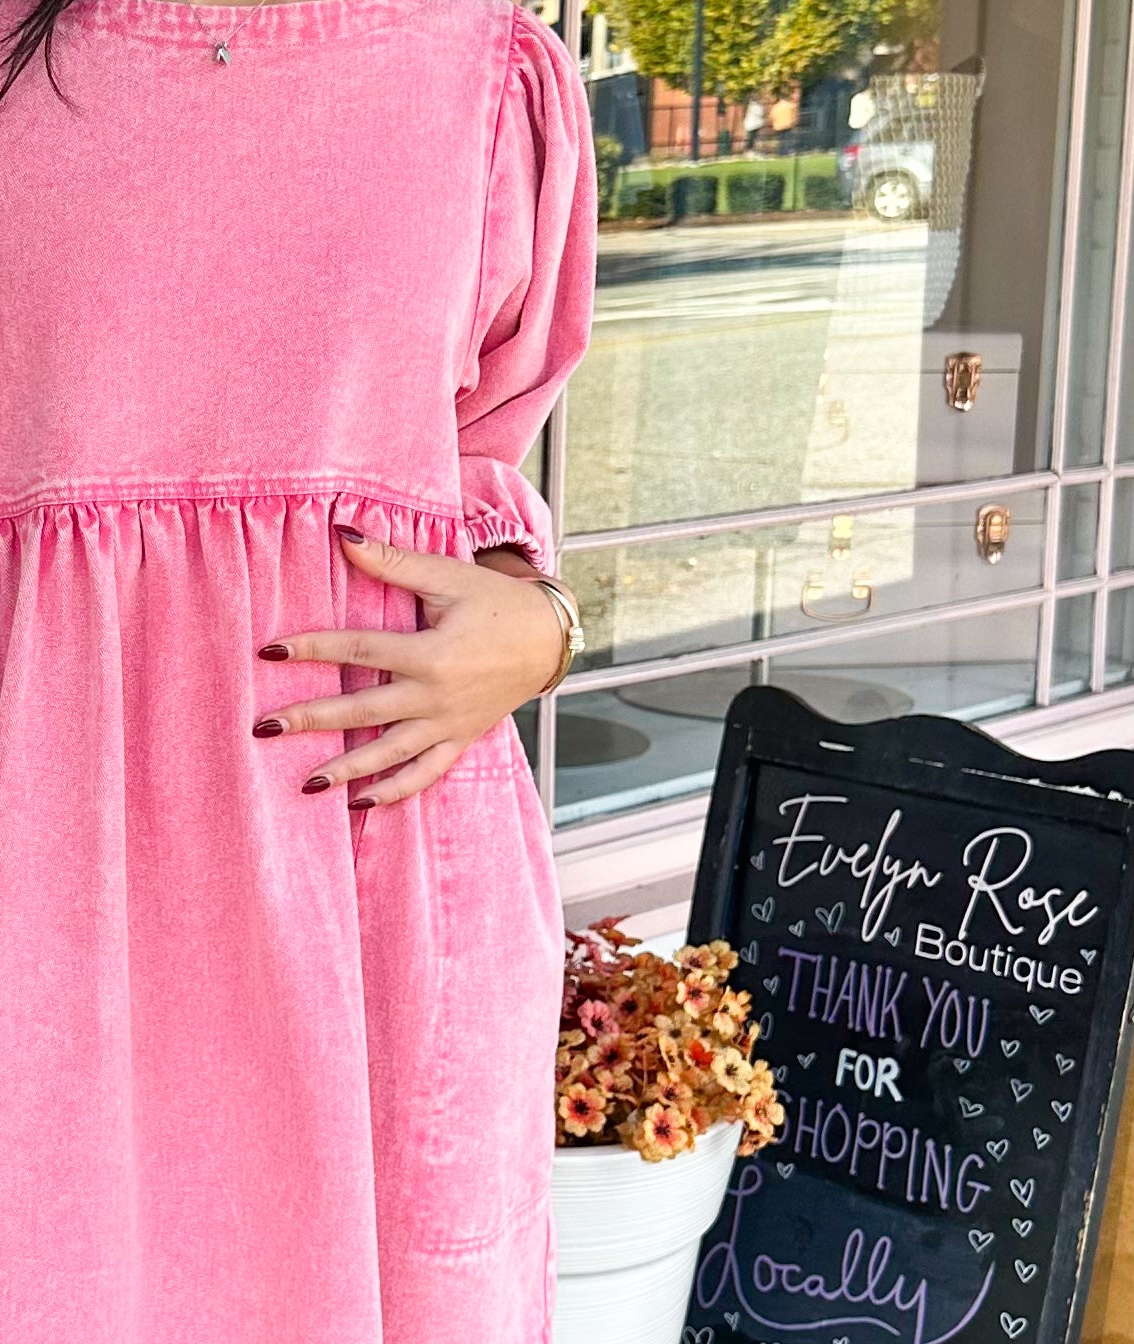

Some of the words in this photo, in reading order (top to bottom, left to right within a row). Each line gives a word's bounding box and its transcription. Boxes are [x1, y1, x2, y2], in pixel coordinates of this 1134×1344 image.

[772, 793, 943, 942] Evelyn
[963, 826, 1099, 946] Rose
[777, 946, 909, 1043] THANK
[919, 975, 991, 1058] YOU
[914, 922, 1084, 994] Boutique
[834, 1047, 904, 1102] FOR
